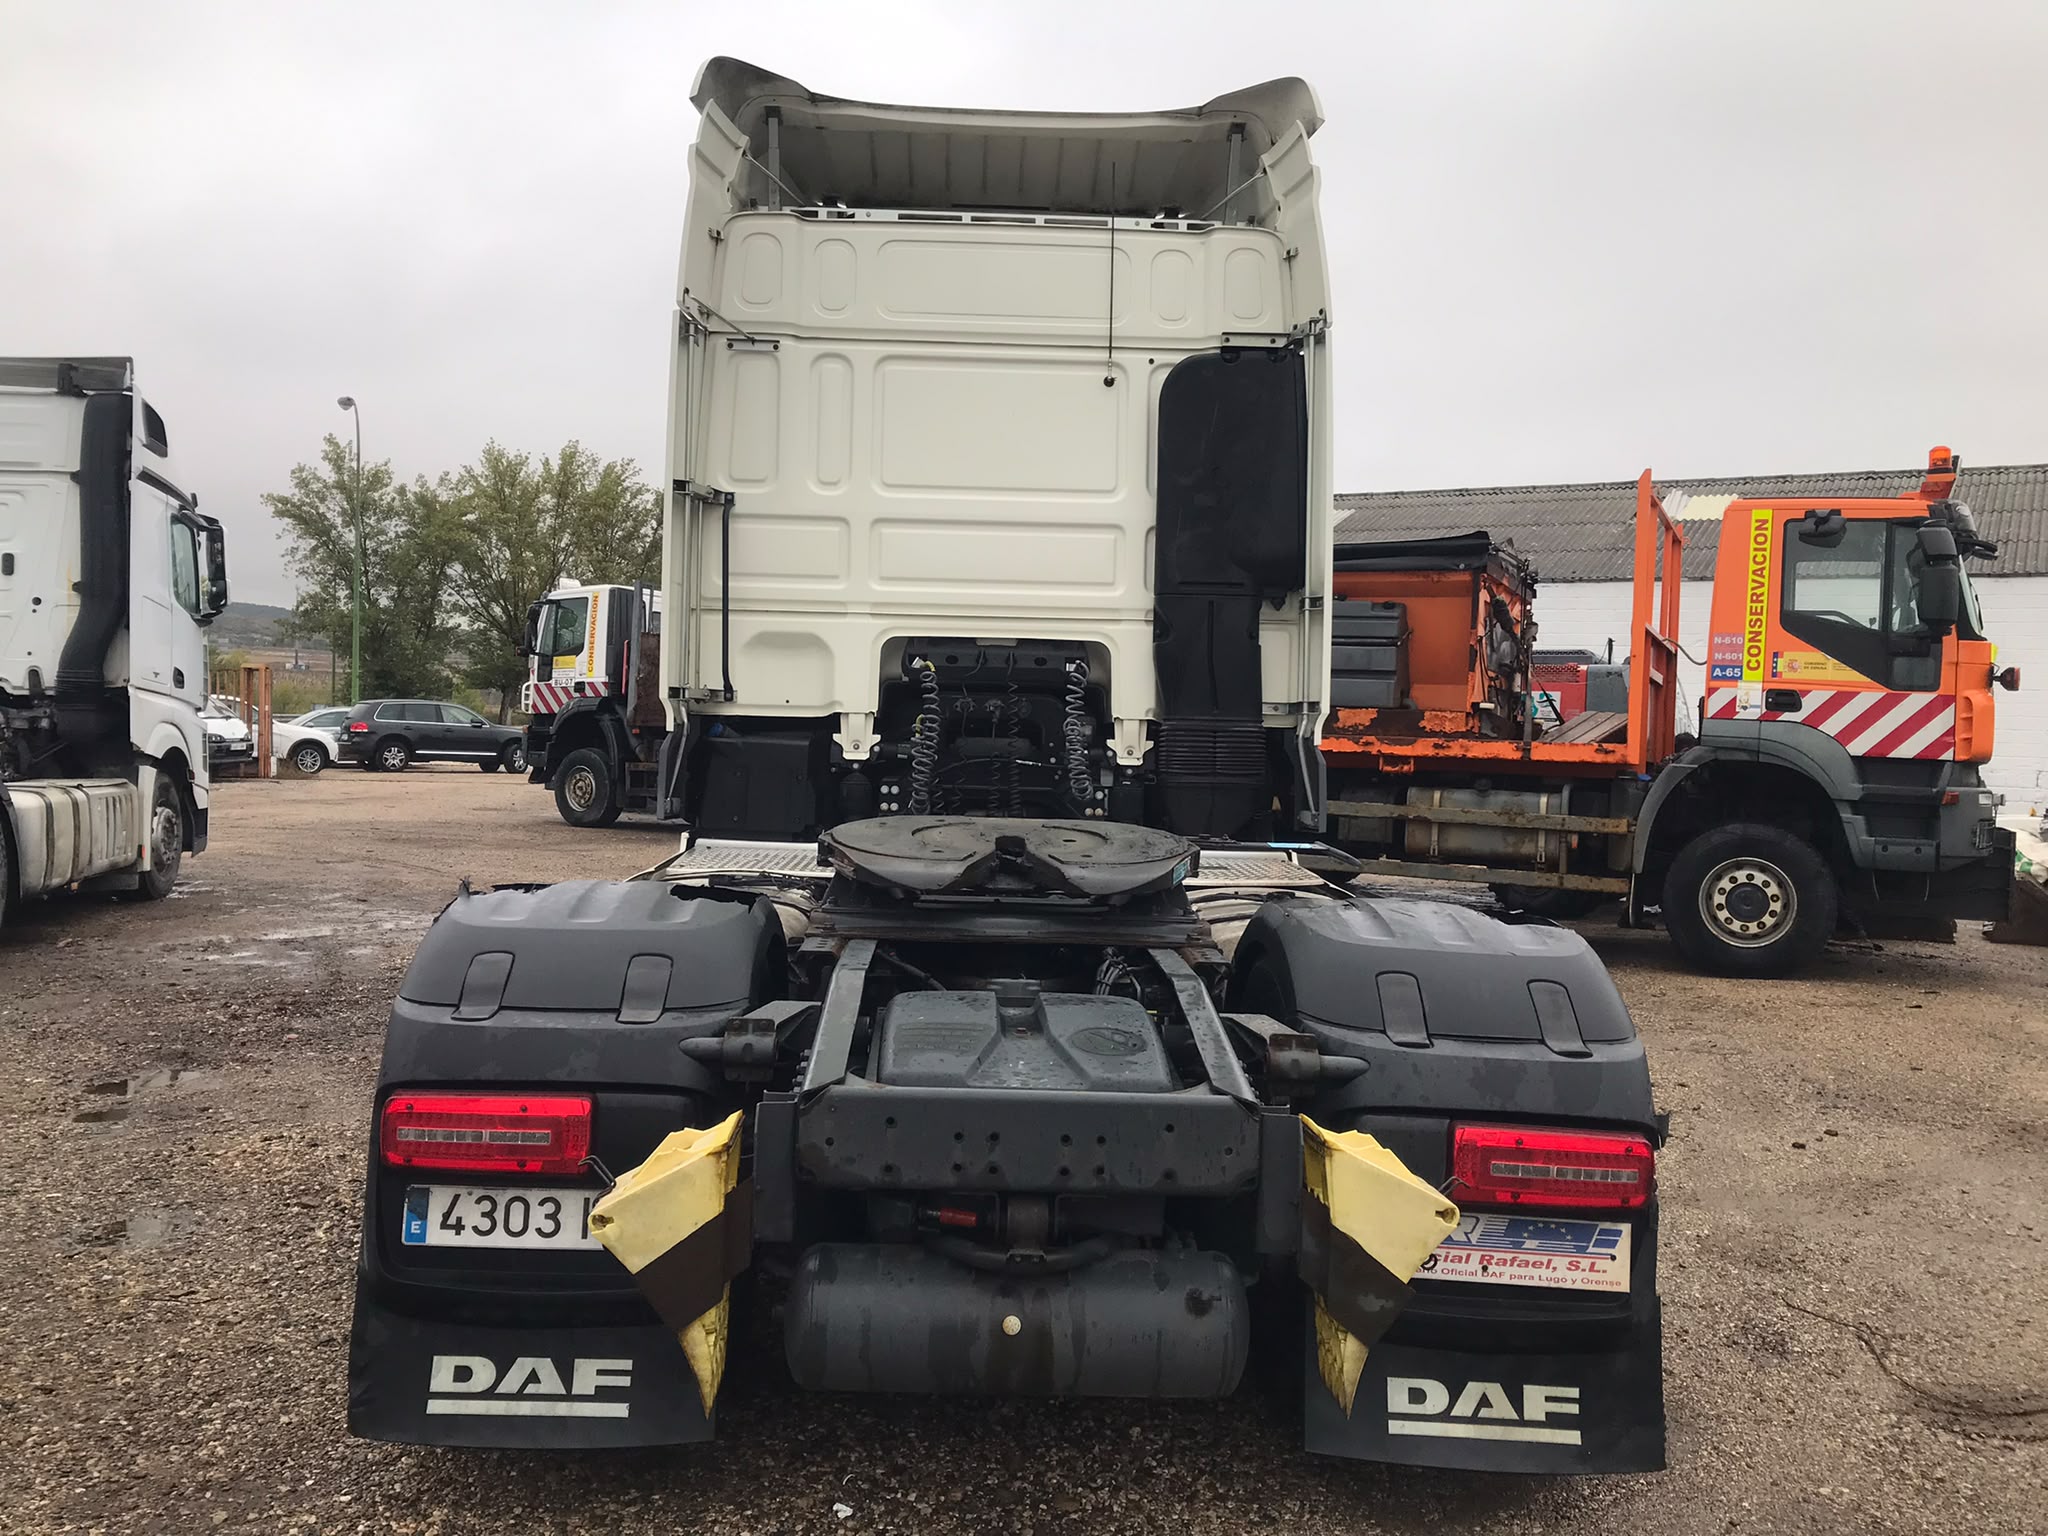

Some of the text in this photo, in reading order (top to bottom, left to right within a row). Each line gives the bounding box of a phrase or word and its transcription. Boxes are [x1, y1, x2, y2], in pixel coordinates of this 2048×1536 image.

[1745, 518, 1770, 672] CONSERVACION
[588, 595, 599, 672] CONSERVACION
[1714, 636, 1744, 645] N-610
[1714, 652, 1743, 660] N-601
[1712, 667, 1742, 677] A-65
[440, 1193, 562, 1239] 4303
[410, 1221, 421, 1234] E
[1479, 1253, 1558, 1273] Rafael,
[1566, 1259, 1608, 1274] S.L.
[1441, 1267, 1478, 1277] Oficial
[1481, 1270, 1506, 1279] DAF
[1509, 1273, 1535, 1281] para
[1538, 1274, 1568, 1284] Lugo
[429, 1355, 634, 1396] DAF
[1386, 1376, 1581, 1422] DAF
